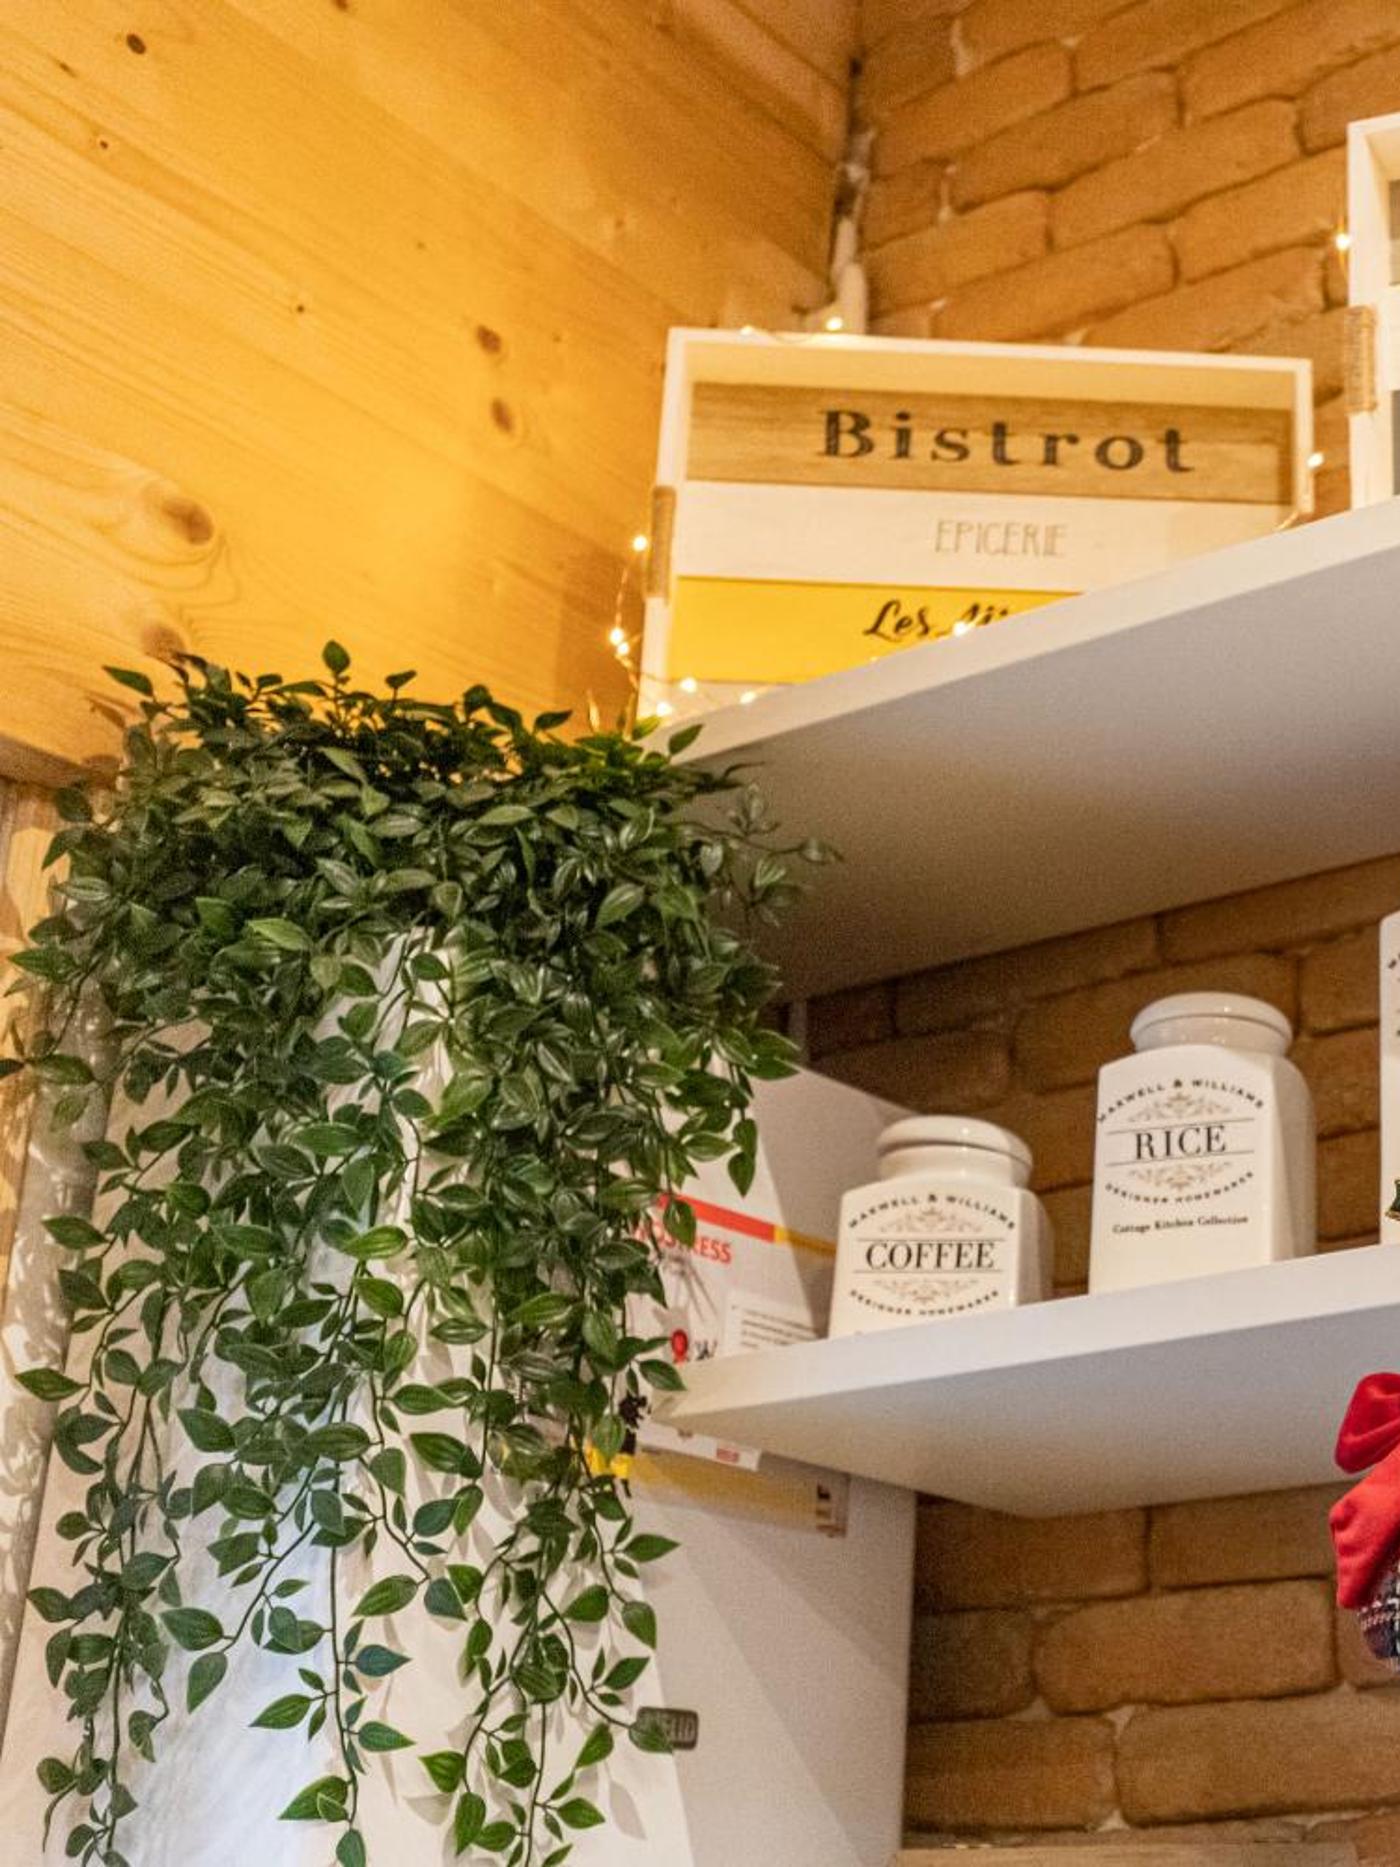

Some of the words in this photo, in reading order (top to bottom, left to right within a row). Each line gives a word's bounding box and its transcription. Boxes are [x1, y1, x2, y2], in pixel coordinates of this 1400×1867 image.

[815, 409, 1194, 472] Bistrot
[934, 519, 1068, 556] EPICERIE
[861, 599, 931, 643] Les
[1192, 1079, 1264, 1108] WILLIAMS
[1135, 1124, 1227, 1161] RICE
[850, 1197, 918, 1229] MAXWELL
[946, 1196, 1015, 1230] WILLIAMS
[1197, 1216, 1249, 1226] Collection
[865, 1241, 996, 1270] COFFEE
